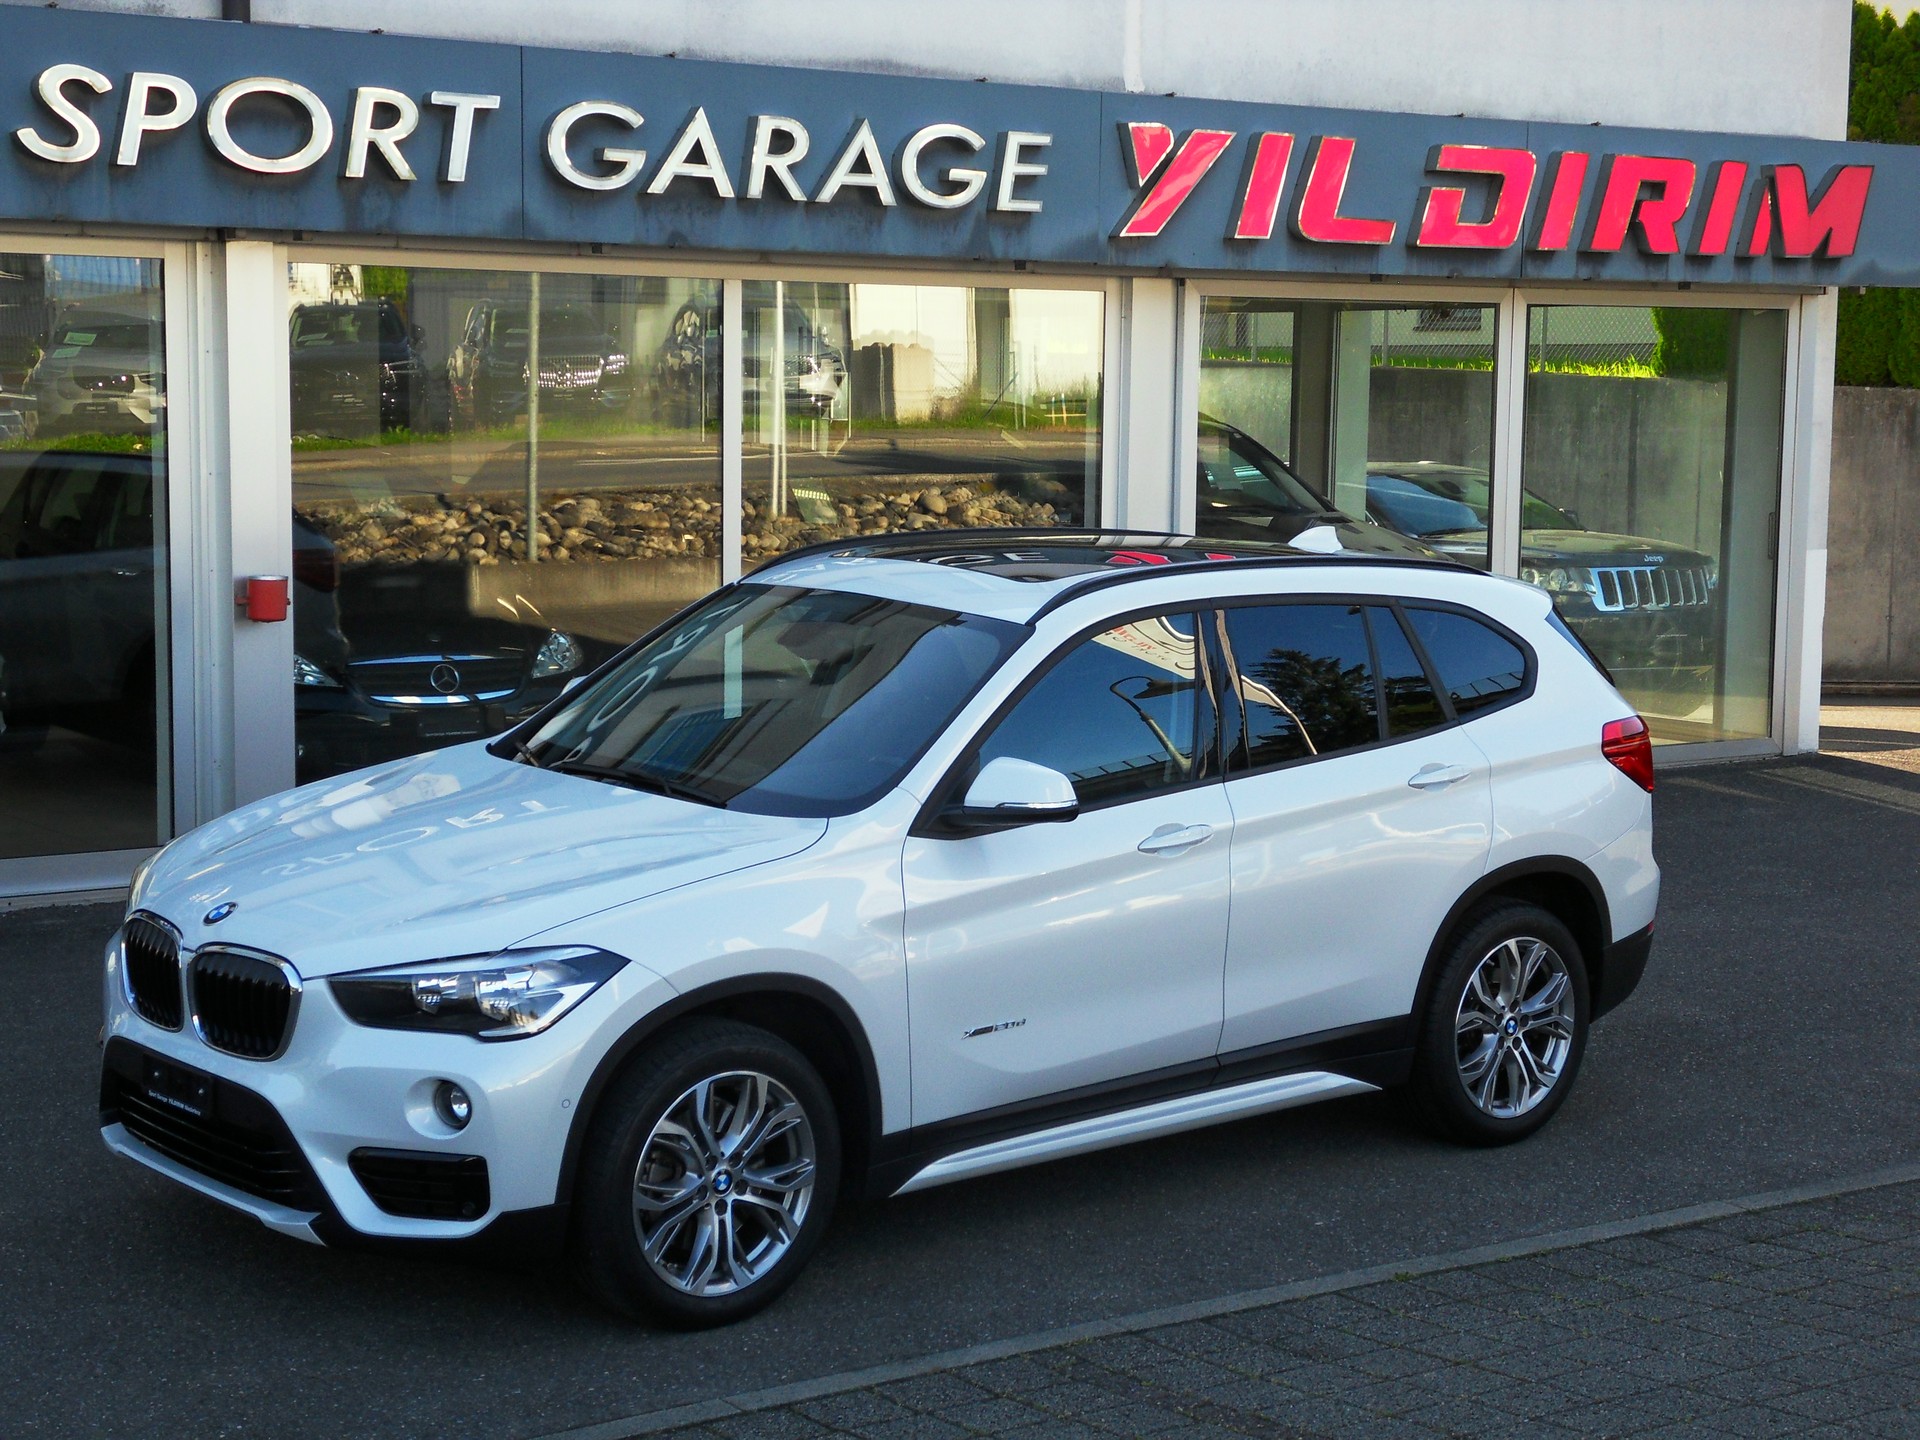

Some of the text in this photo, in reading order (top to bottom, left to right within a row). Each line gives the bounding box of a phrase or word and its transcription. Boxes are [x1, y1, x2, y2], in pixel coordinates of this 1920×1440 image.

[16, 63, 1876, 258] SPORT GARAGE YILDIRIM
[1643, 554, 1664, 563] Jeep
